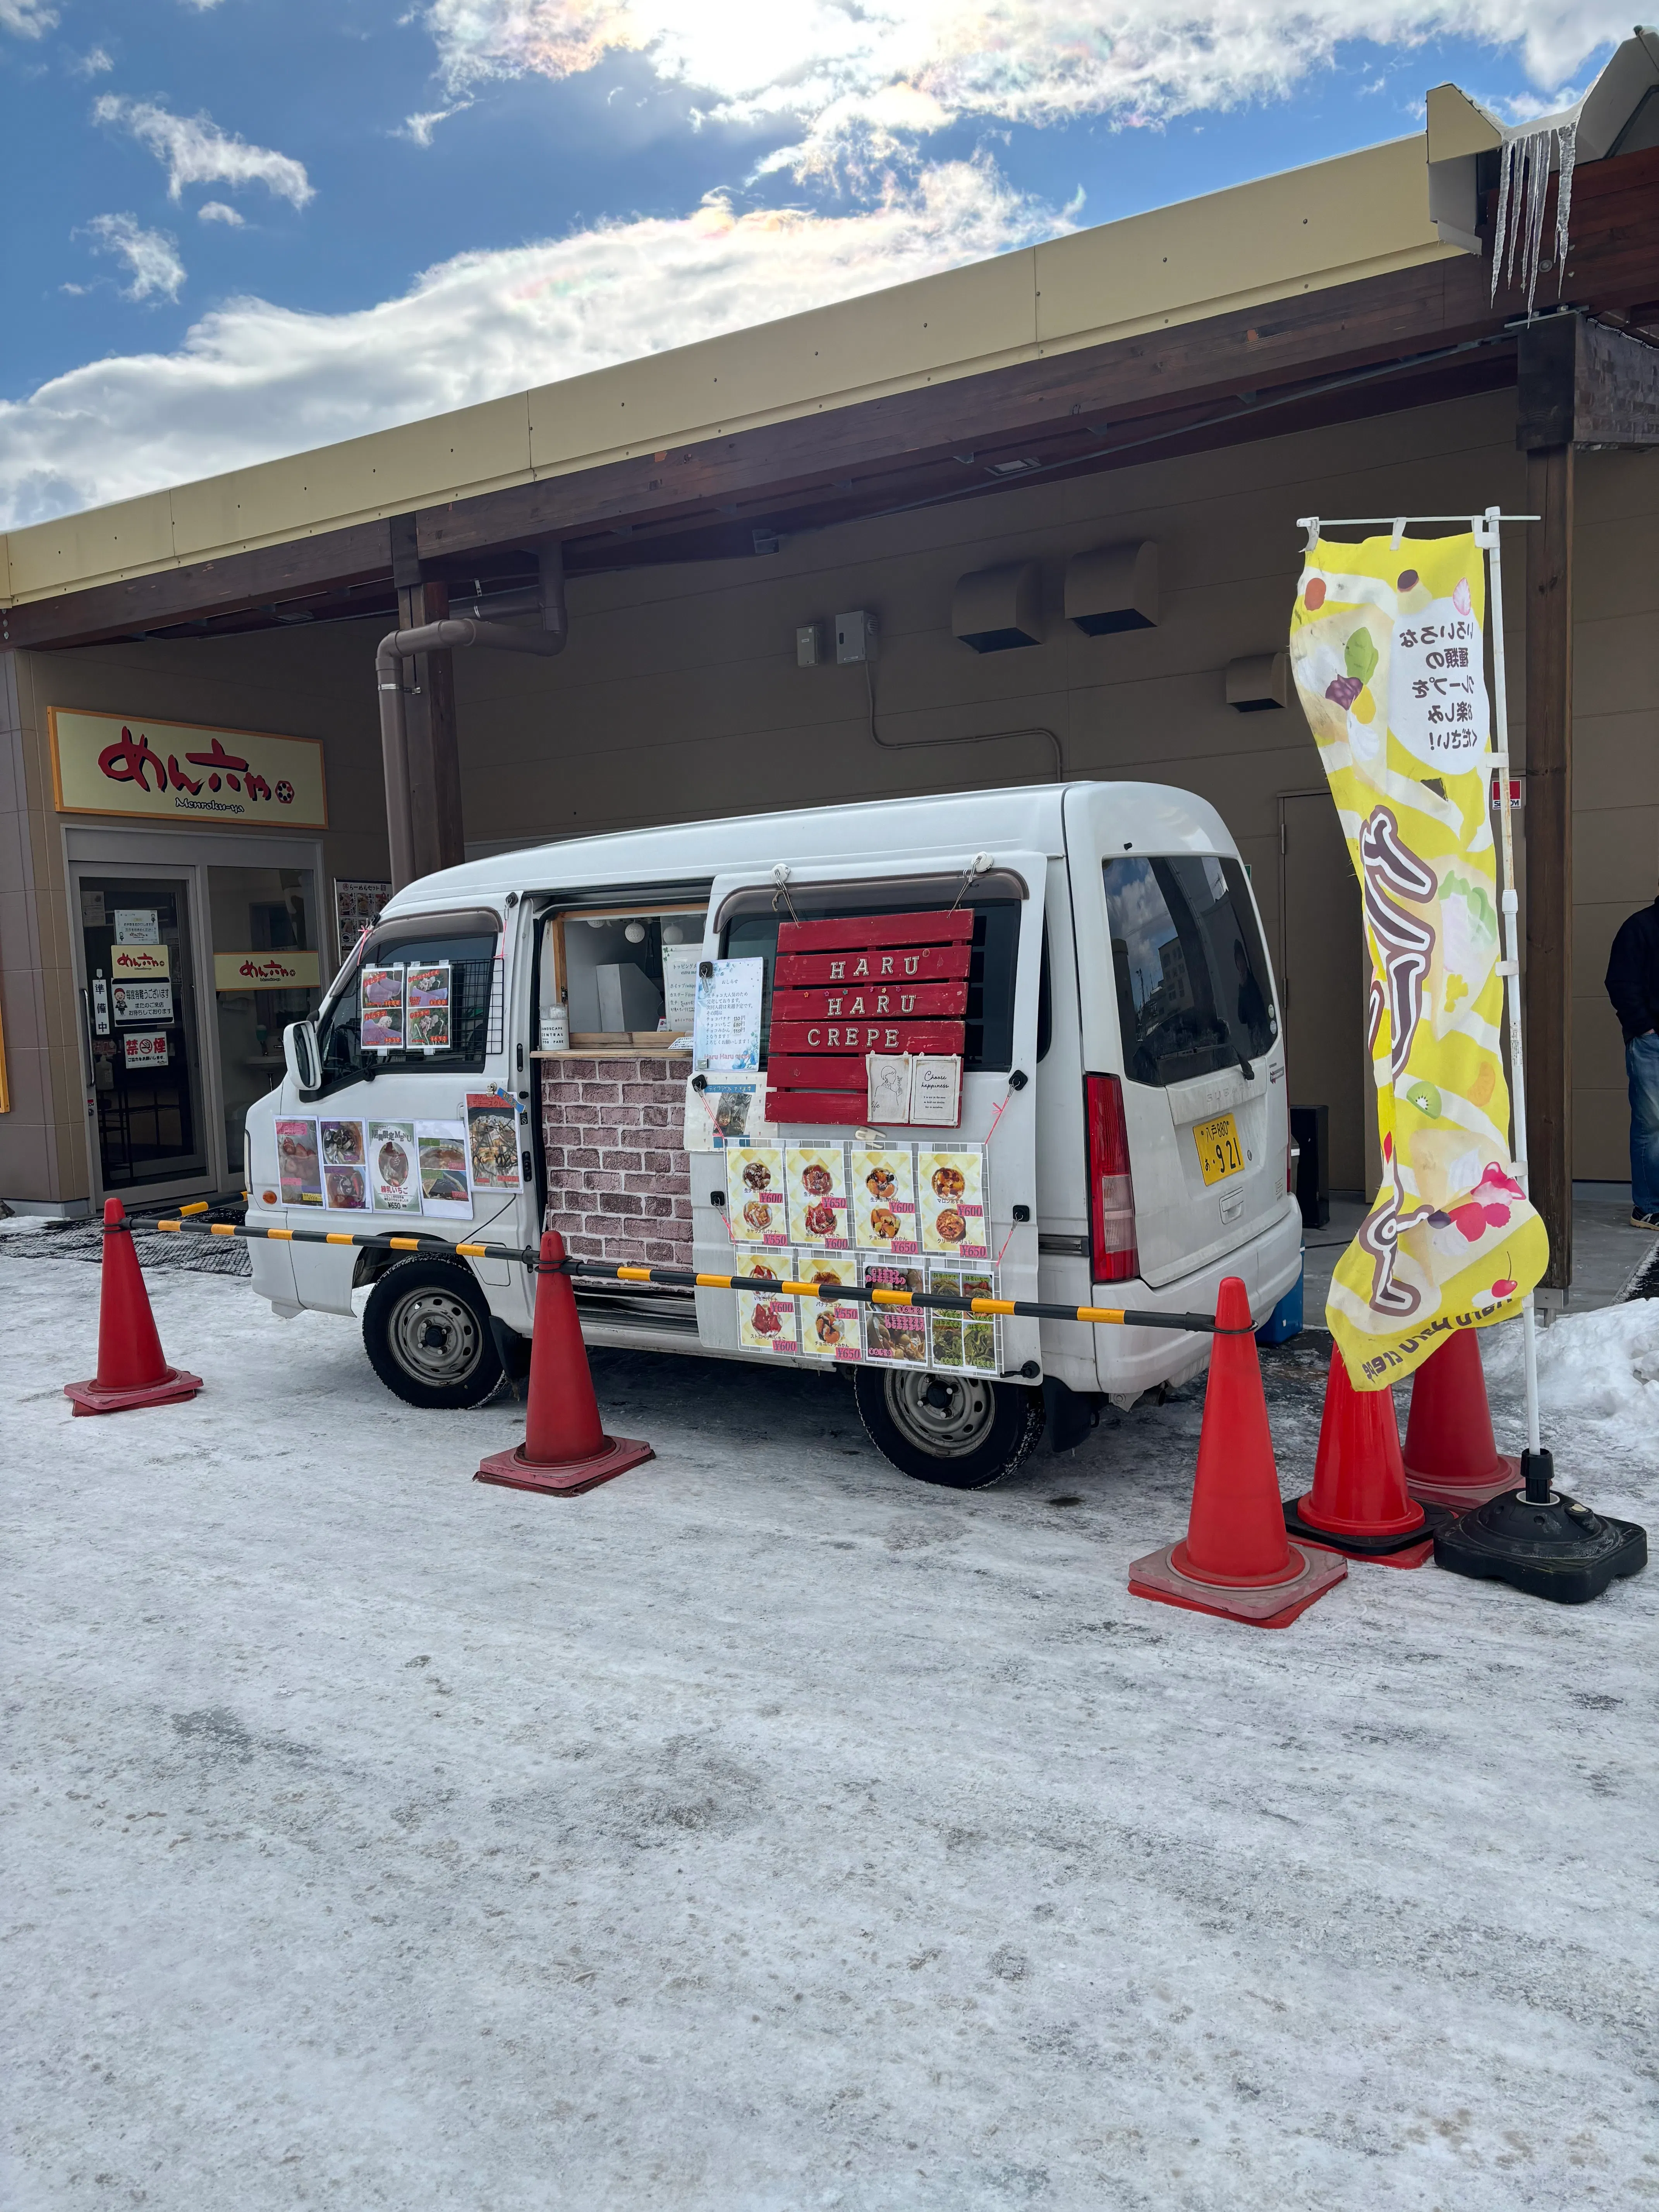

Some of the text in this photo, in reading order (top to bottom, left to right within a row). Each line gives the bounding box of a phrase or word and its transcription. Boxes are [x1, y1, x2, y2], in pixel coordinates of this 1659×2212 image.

[175, 797, 244, 813] Menroku-ya
[830, 955, 919, 979] HARU
[95, 984, 107, 1032] 準備中
[828, 994, 916, 1016] HARU
[807, 1028, 899, 1048] CREPE
[924, 1071, 946, 1081] Choose
[761, 1194, 782, 1202] ¥600
[823, 1198, 846, 1208] ¥650
[891, 1203, 914, 1213] ¥600
[958, 1206, 982, 1216] ¥600
[765, 1235, 786, 1245] ¥550
[826, 1239, 847, 1249] ¥600
[893, 1242, 916, 1252] ¥650
[962, 1246, 986, 1256] ¥650
[772, 1303, 793, 1312] ¥600
[835, 1309, 857, 1318] ¥550
[775, 1341, 796, 1350] ¥600
[838, 1349, 860, 1359] ¥650
